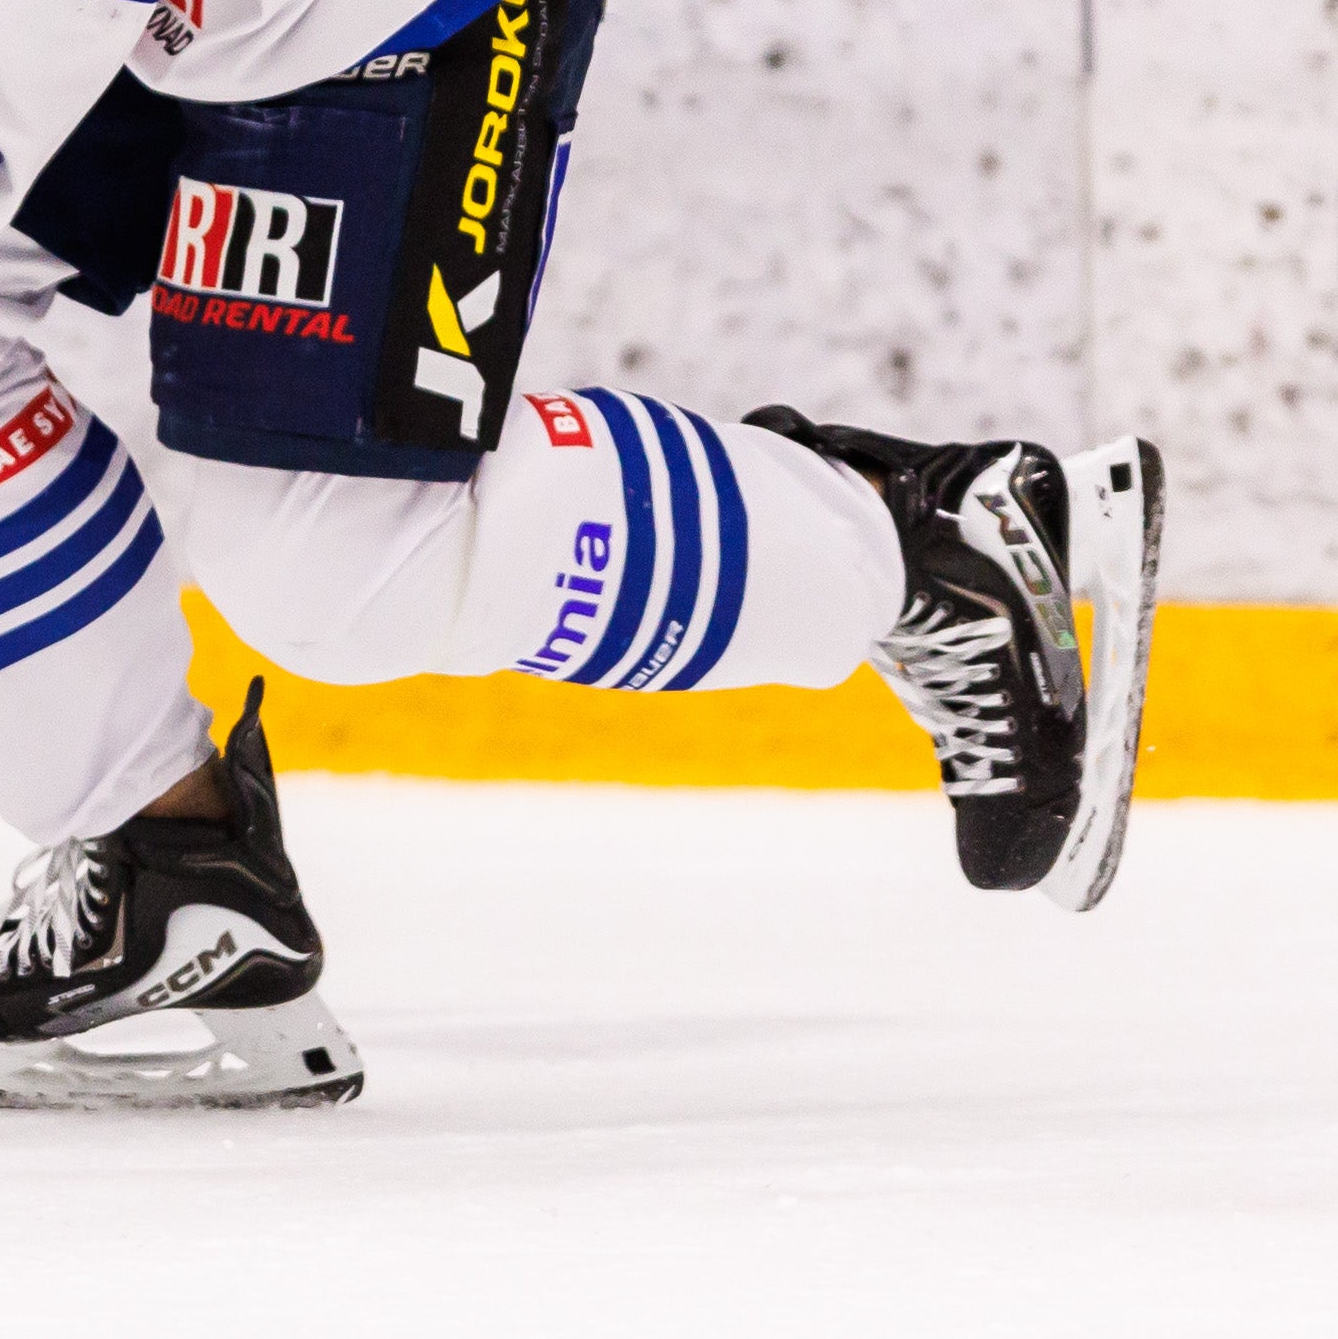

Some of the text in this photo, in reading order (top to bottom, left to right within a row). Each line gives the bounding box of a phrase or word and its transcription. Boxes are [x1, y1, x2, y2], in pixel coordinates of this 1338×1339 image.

[201, 297, 356, 344] RENTAL
[512, 520, 613, 676] lmia
[136, 928, 239, 1008] CCM
